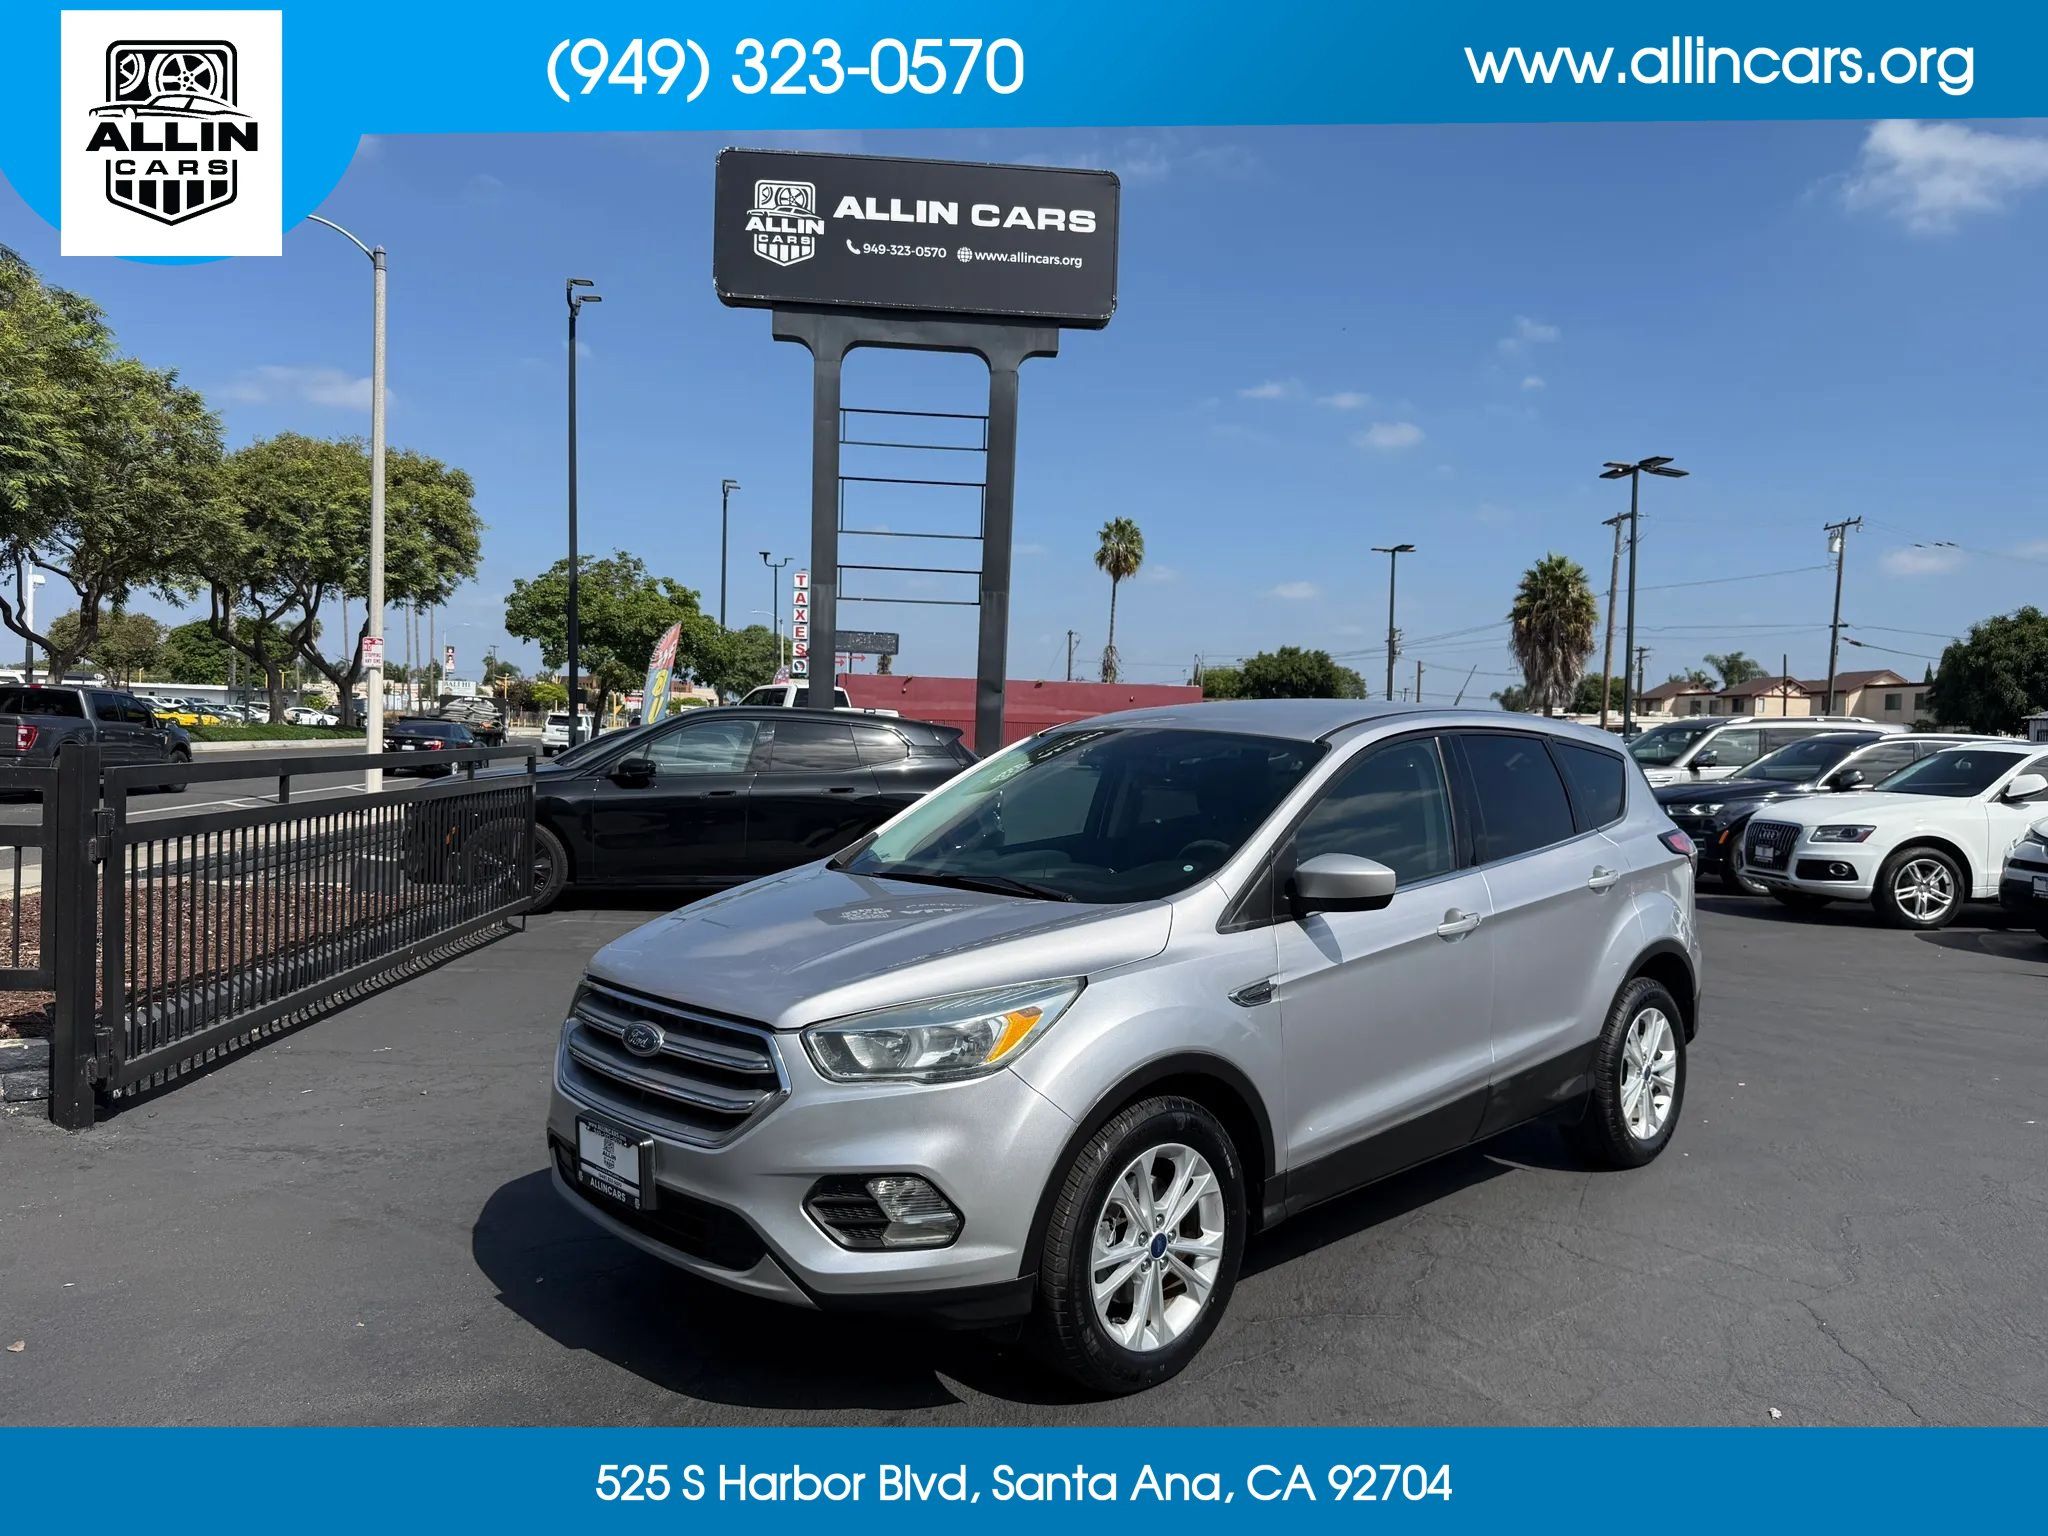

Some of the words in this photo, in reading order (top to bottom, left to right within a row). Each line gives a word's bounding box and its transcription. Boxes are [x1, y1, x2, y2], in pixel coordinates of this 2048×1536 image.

[833, 195, 959, 225] ALLIN
[971, 203, 1097, 233] CARS
[745, 216, 825, 235] ALLIN
[758, 234, 811, 245] CARS
[863, 243, 947, 258] 949-323-0570
[974, 251, 1083, 268] www.allincars.org
[795, 575, 807, 656] TAXES
[590, 1177, 627, 1203] ALLINCARS
